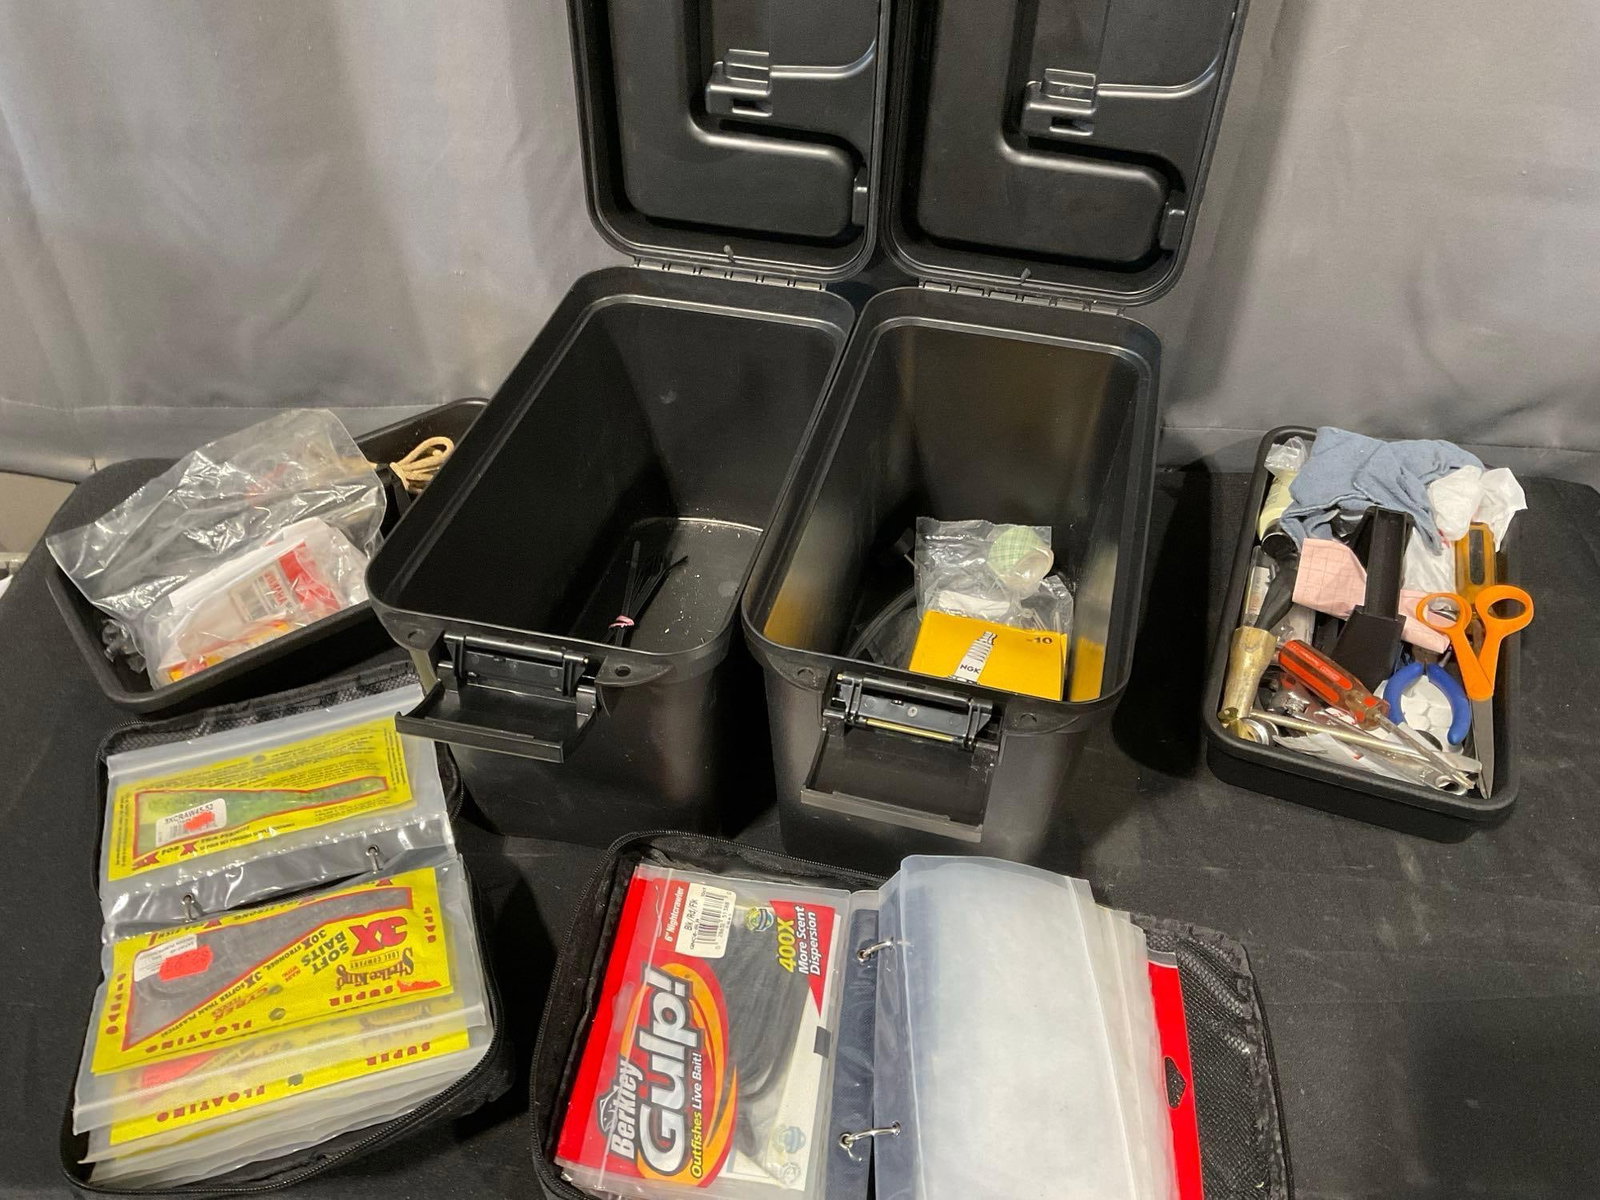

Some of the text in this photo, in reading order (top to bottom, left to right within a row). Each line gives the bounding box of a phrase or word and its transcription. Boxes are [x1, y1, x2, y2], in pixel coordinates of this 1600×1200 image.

[960, 664, 981, 675] NGK
[666, 886, 684, 933] Nightcrawler
[301, 930, 327, 951] 30X
[301, 931, 346, 966] BAITS
[348, 916, 408, 956] 3X
[777, 917, 795, 974] 400X
[796, 905, 808, 975] More Scent
[808, 911, 822, 977] Dispersion
[312, 943, 349, 975] SOFT
[336, 947, 414, 991] Strike King
[350, 956, 382, 969] COMPANY
[219, 982, 245, 1002] SOFTER
[330, 985, 393, 1006] SUPER
[145, 1019, 252, 1054] FLOATING
[365, 1041, 431, 1066] SUPER
[639, 963, 699, 1173] Gulp!
[156, 1084, 265, 1122] FLOATING
[610, 1057, 643, 1160] Berkley
[689, 1052, 703, 1179] Outfishes Live Bait!
